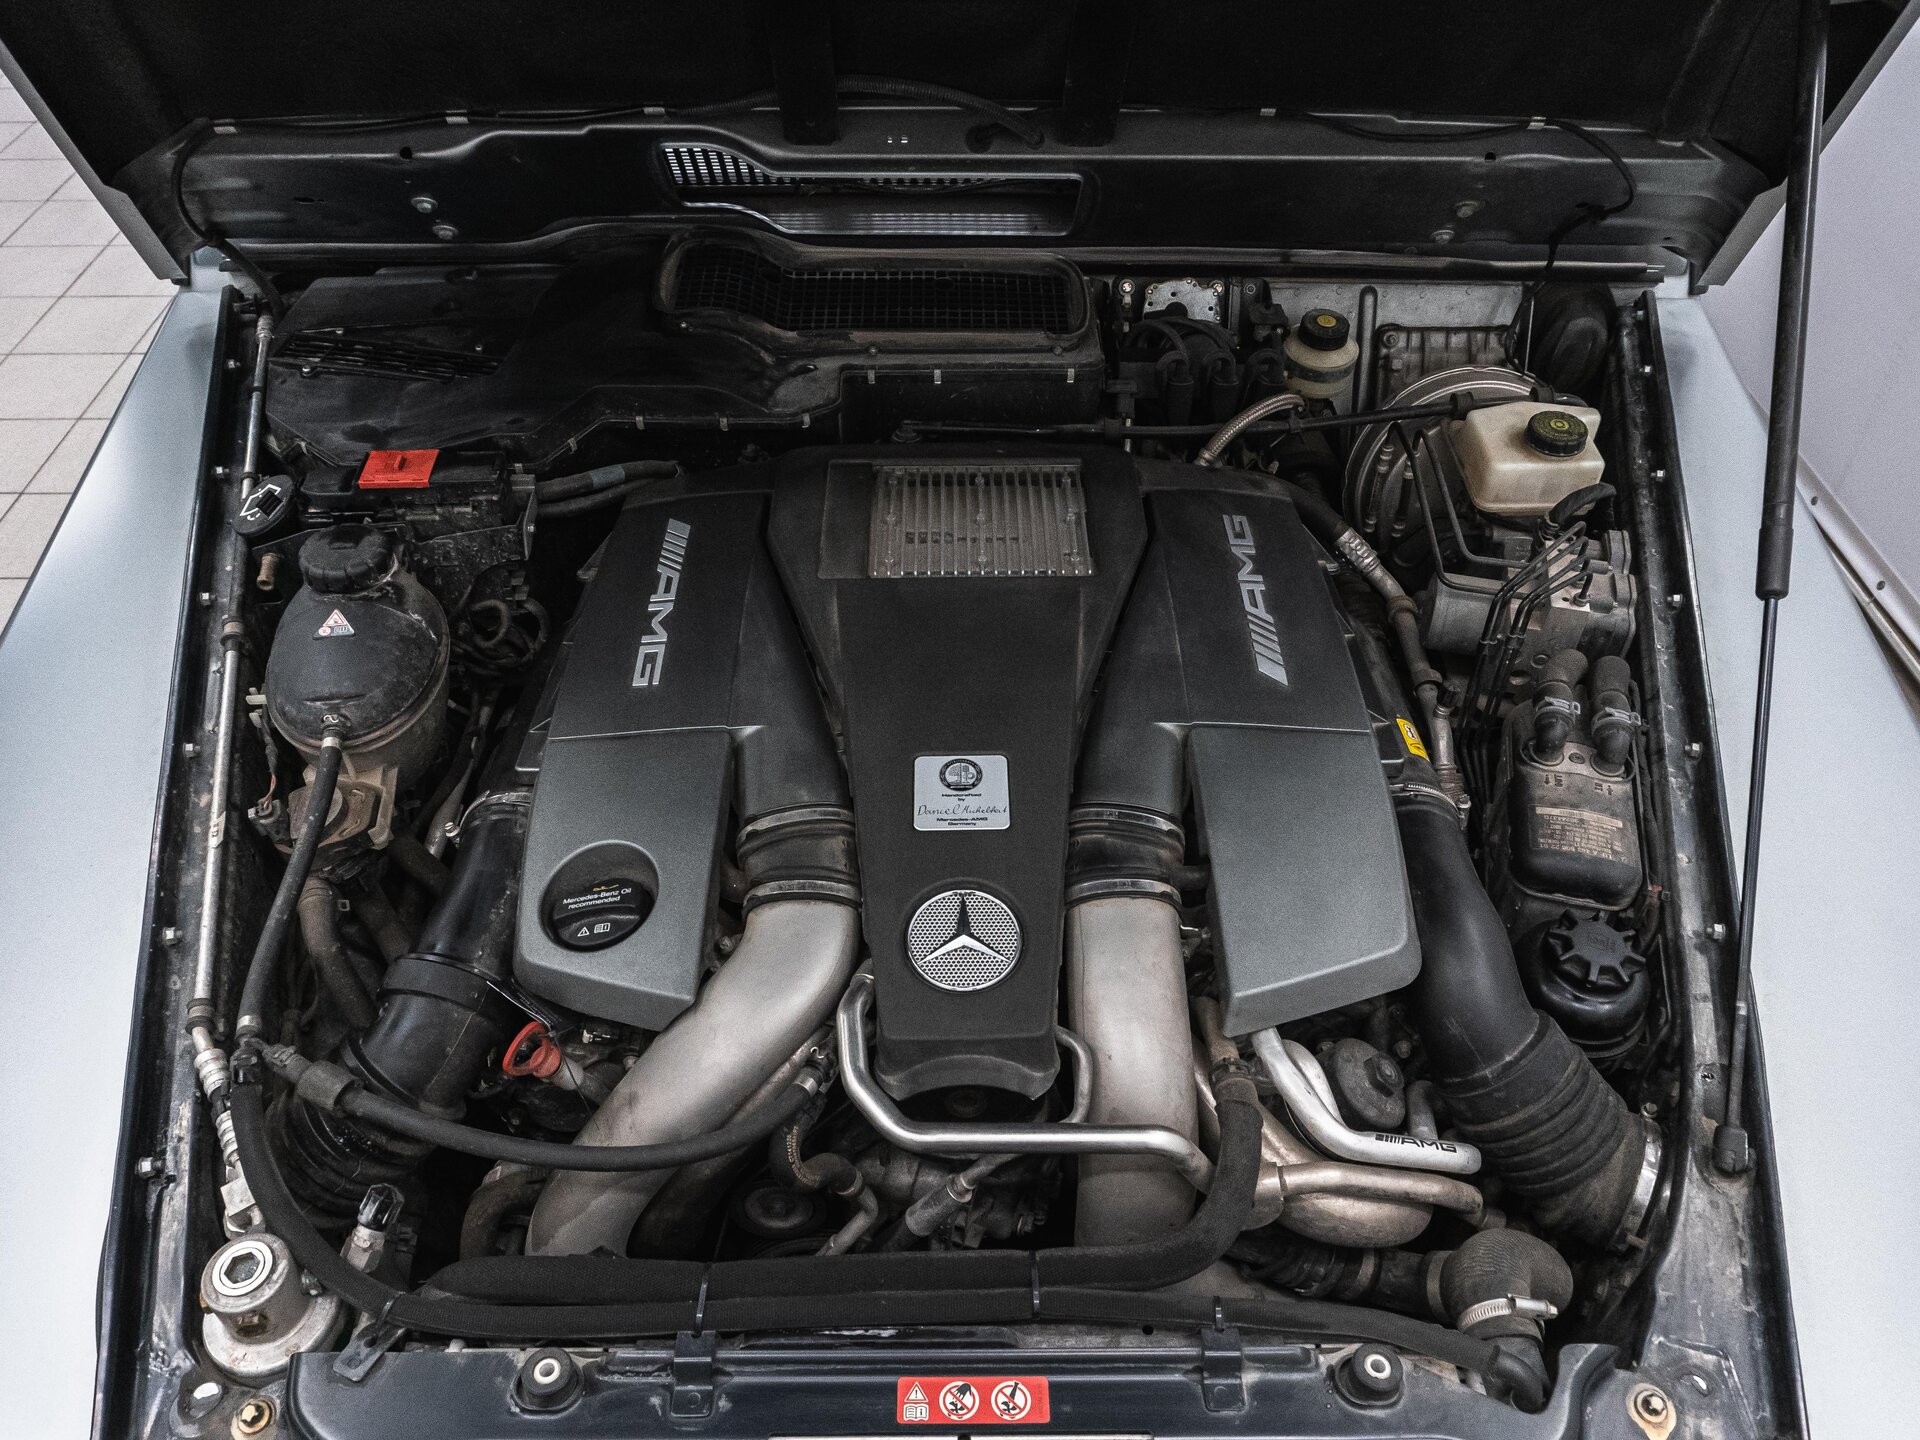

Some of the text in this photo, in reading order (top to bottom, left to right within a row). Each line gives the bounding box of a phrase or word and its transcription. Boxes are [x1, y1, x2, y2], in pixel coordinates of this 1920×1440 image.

[1222, 514, 1276, 625] AMG
[633, 563, 680, 687] AMG
[562, 887, 633, 905] Mercedes-Benz Oil
[567, 895, 621, 910] recommended
[1400, 1137, 1458, 1154] AMG
